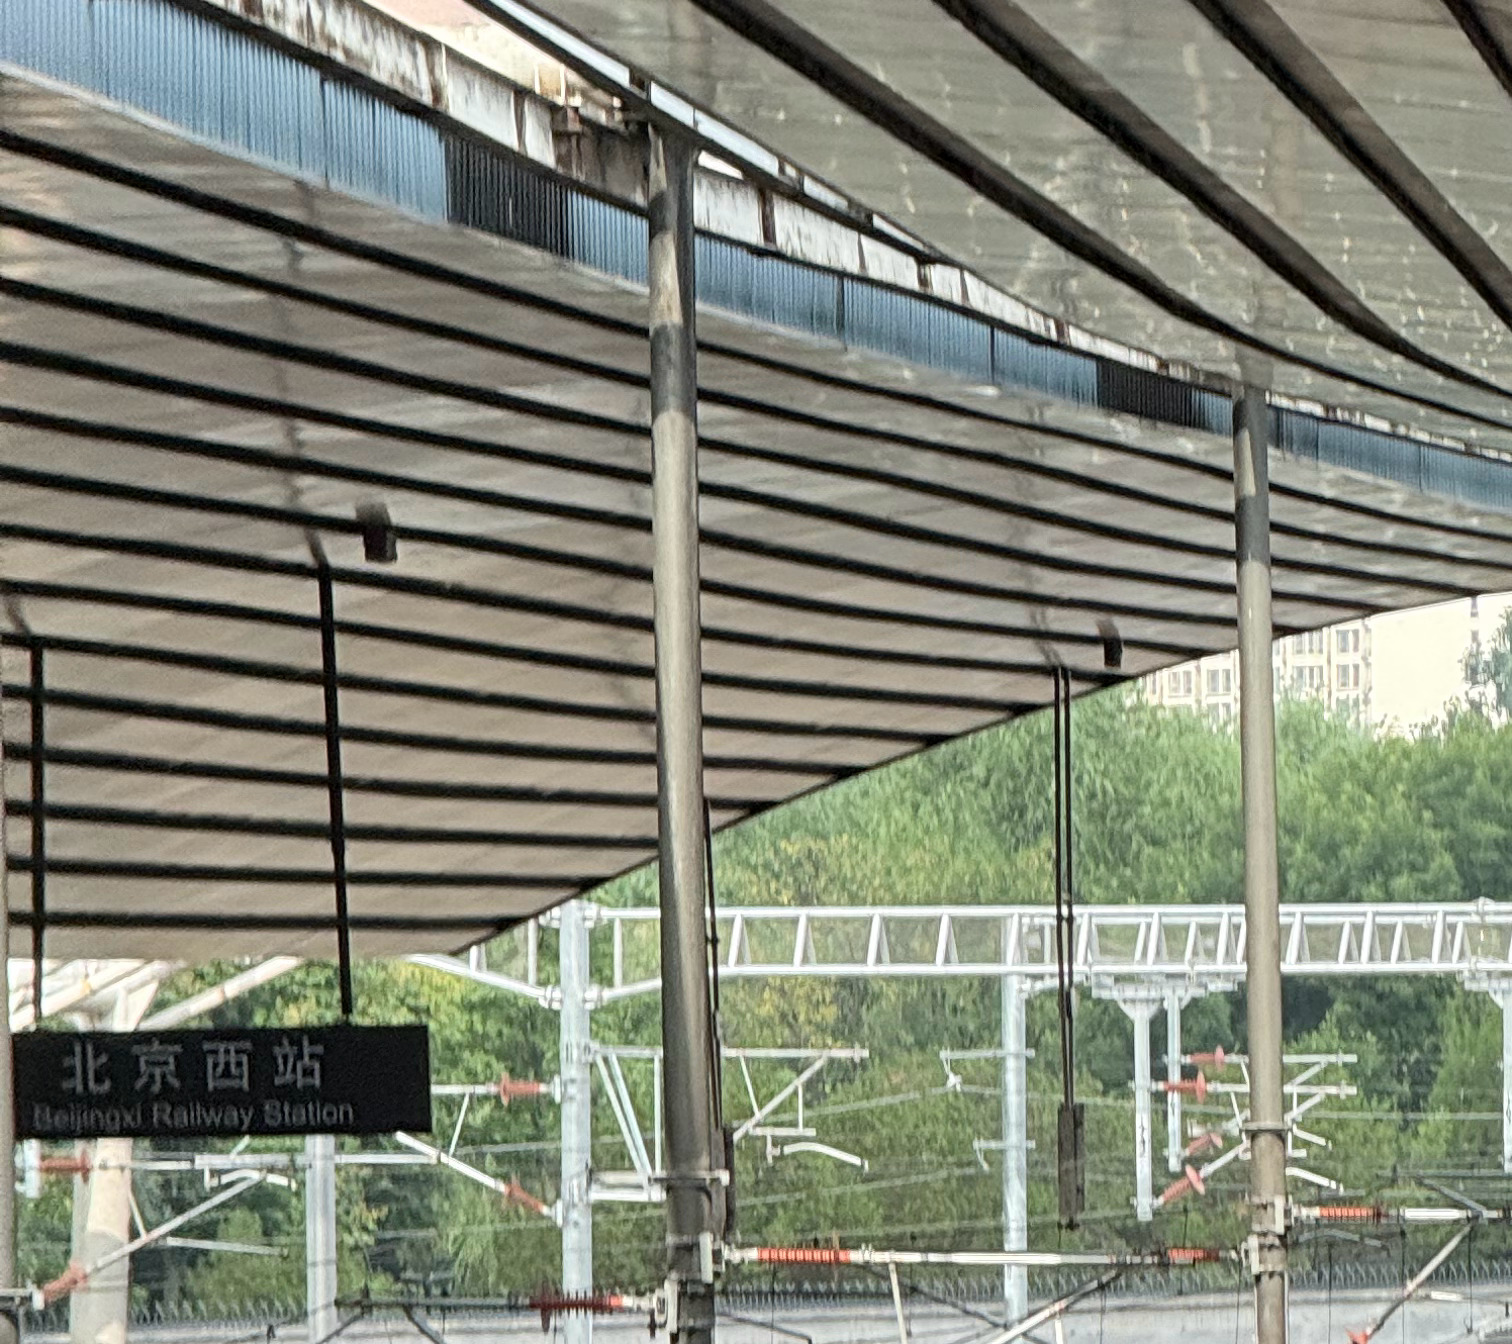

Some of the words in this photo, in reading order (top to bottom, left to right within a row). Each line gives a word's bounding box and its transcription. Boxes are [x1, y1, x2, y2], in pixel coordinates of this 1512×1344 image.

[61, 1037, 326, 1096] 北京西站
[152, 1101, 254, 1132] Railway
[264, 1099, 354, 1129] Station
